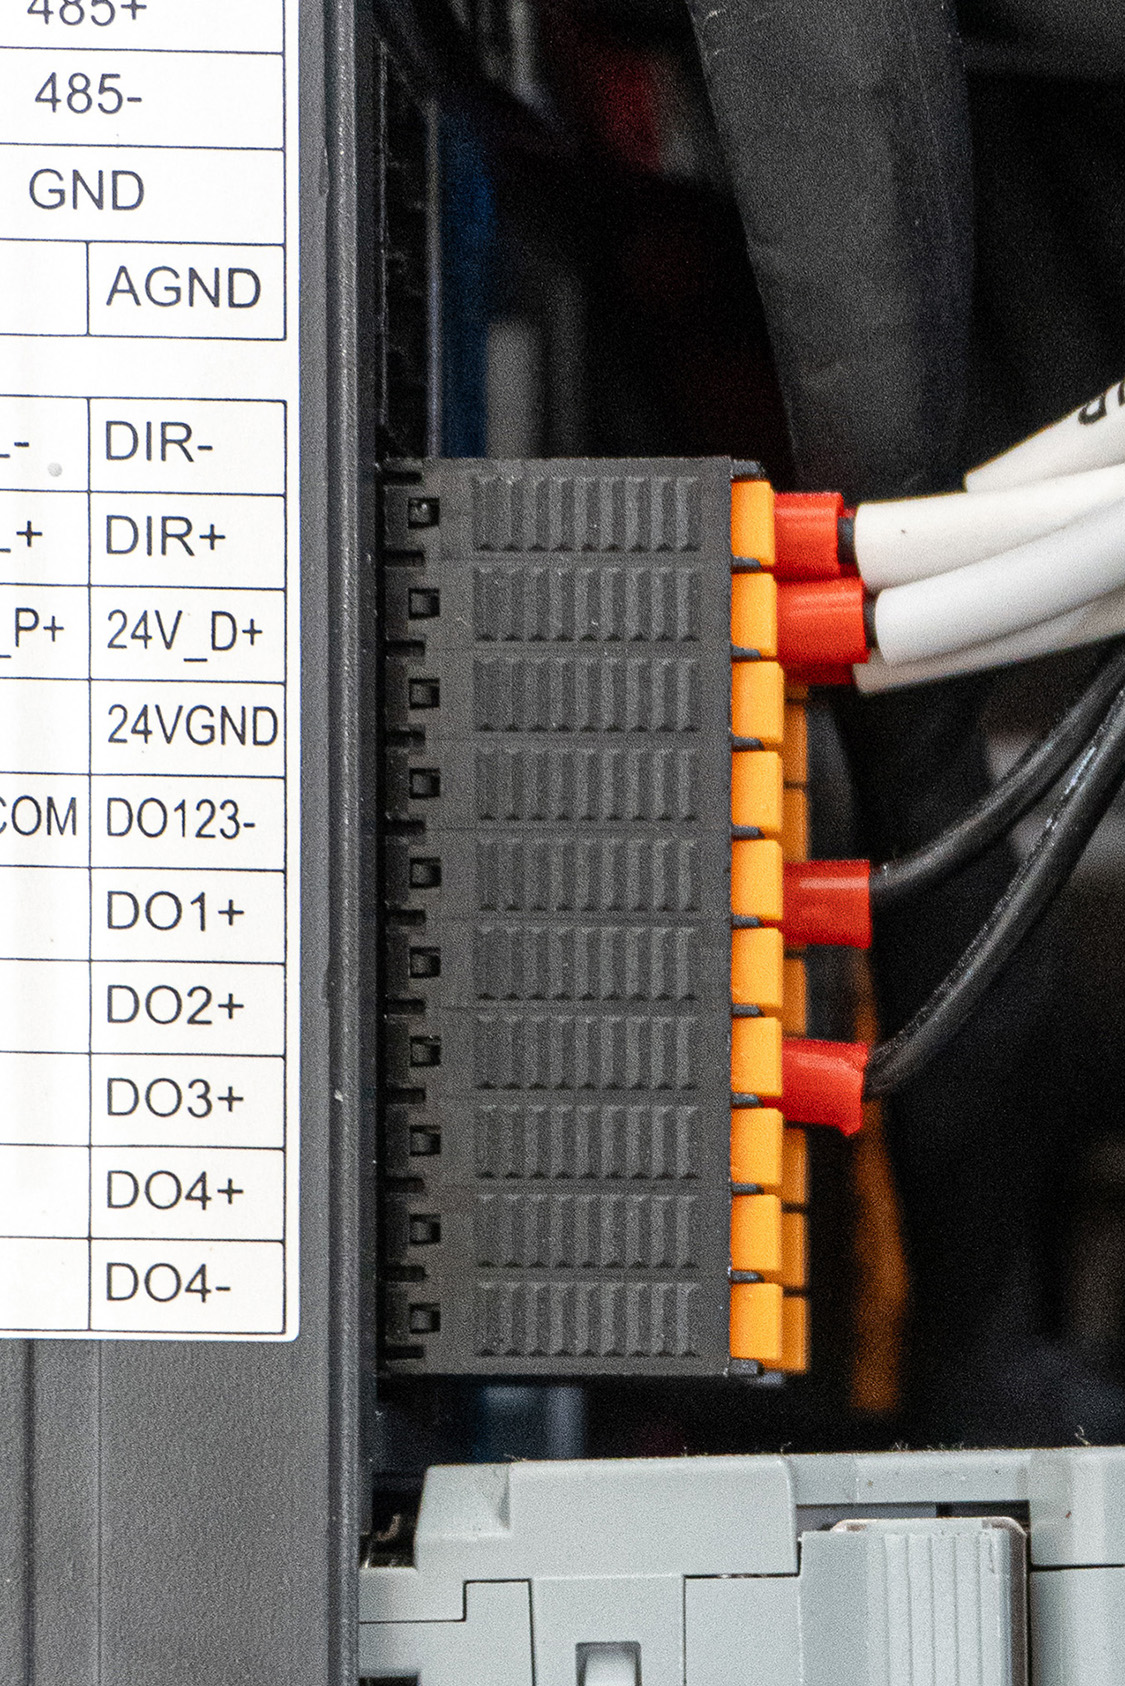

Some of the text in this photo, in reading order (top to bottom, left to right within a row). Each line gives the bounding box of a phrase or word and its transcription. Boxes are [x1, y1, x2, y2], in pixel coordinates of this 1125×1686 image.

[28, 0, 148, 28] 485+
[35, 73, 143, 116] 485-
[30, 169, 145, 212] GND
[106, 266, 262, 310] AGND
[106, 421, 214, 464] DIR-
[107, 515, 227, 558] DIR+
[108, 610, 264, 664] 24V_D+
[108, 705, 279, 748] 24VGND
[107, 798, 257, 841] DO123-
[108, 891, 246, 933] DO1+
[108, 985, 246, 1026] DO2+
[108, 1078, 245, 1120] DO3+
[108, 1171, 245, 1212] DO4+
[107, 1263, 232, 1304] DO4-
